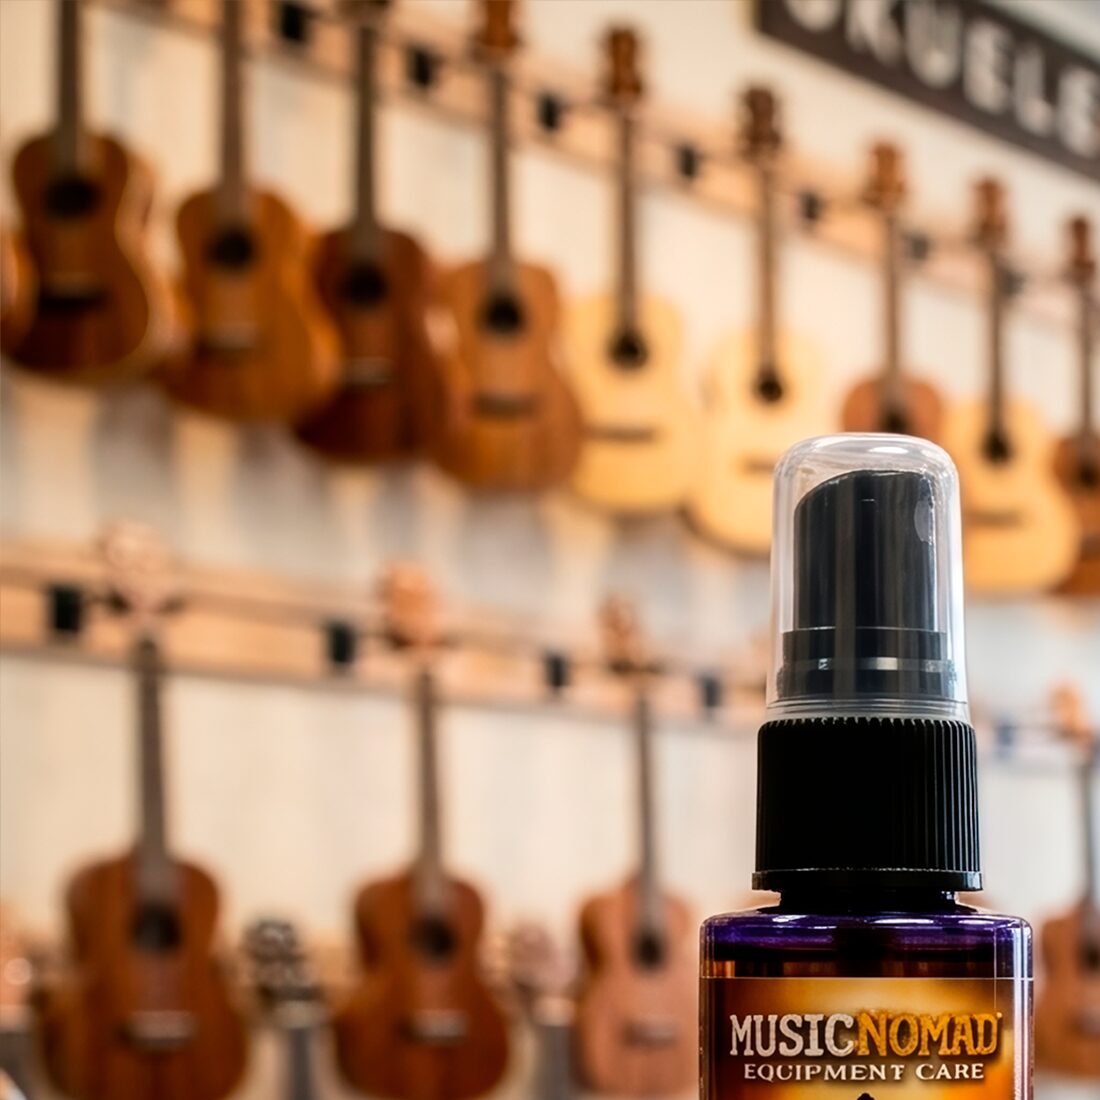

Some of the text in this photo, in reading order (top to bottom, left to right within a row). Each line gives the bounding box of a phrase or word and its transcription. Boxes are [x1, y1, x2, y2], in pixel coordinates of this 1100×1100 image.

[729, 1011, 1003, 1057] MUSICNOMAD
[744, 1063, 984, 1082] EQUIPMENT CARE
